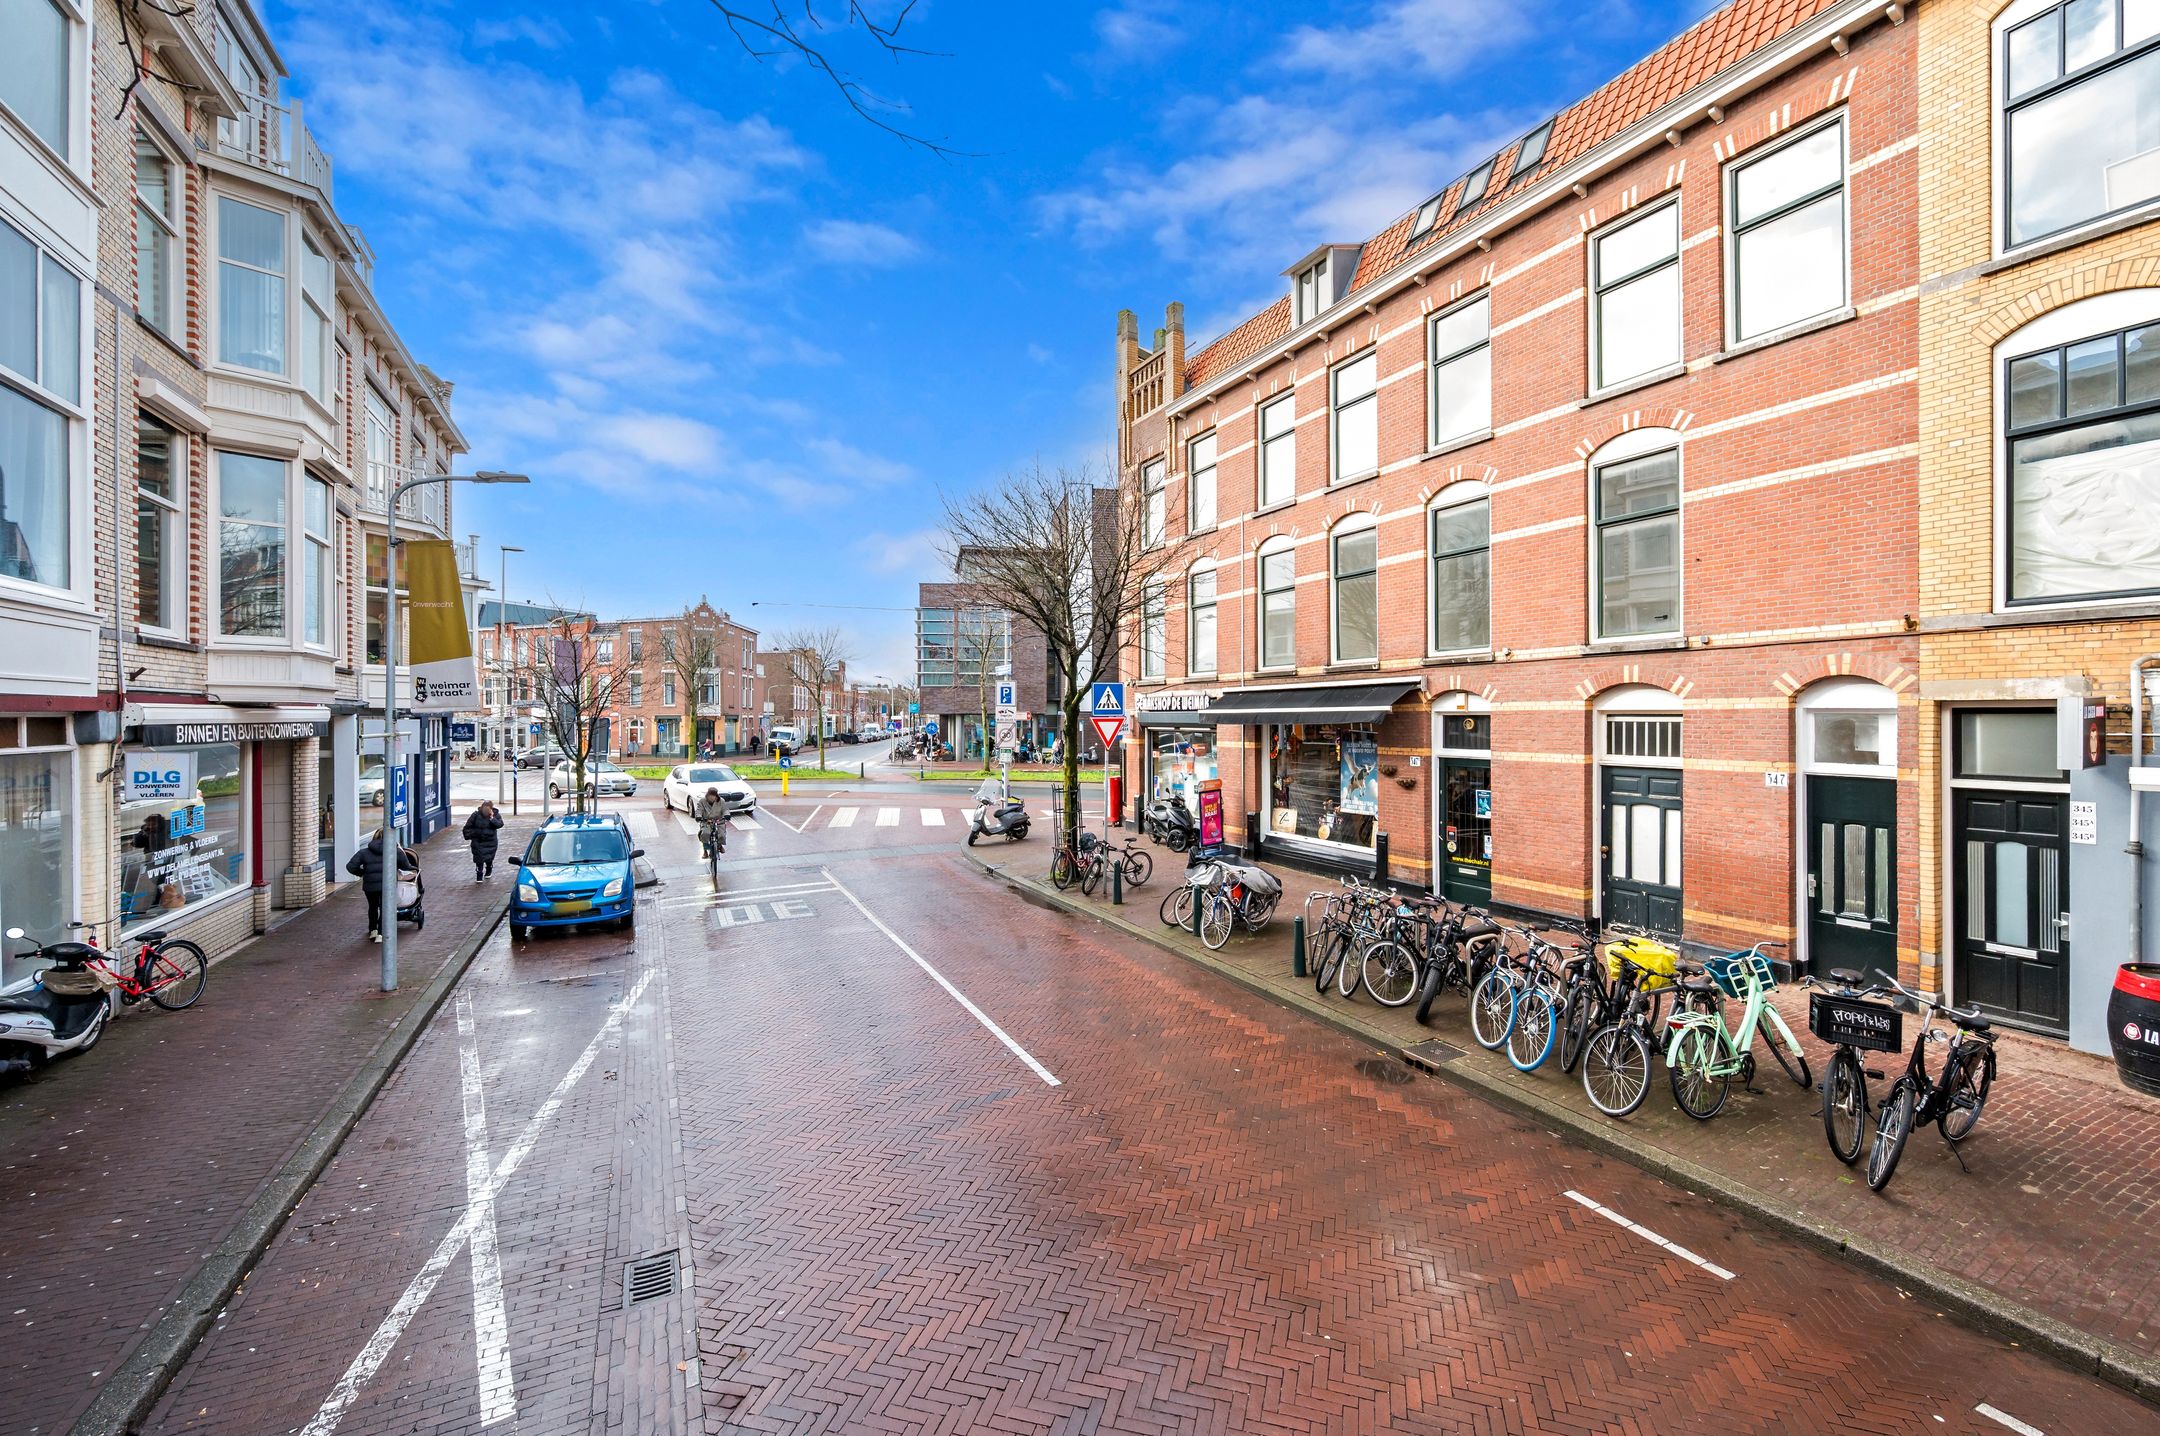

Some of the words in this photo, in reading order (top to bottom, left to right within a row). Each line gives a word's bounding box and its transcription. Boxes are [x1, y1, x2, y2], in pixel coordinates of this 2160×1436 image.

[428, 681, 471, 690] weimar
[176, 724, 220, 744] BINNEN
[222, 723, 237, 742] EN
[237, 722, 314, 741] BUITENZONWERING
[133, 770, 181, 784] DLG
[396, 770, 404, 797] P
[2073, 805, 2093, 813] 345
[170, 805, 205, 840] DLG
[153, 842, 189, 861] ZONWERING
[195, 835, 219, 849] VLOEREN
[2144, 1028, 2160, 1046] LA
